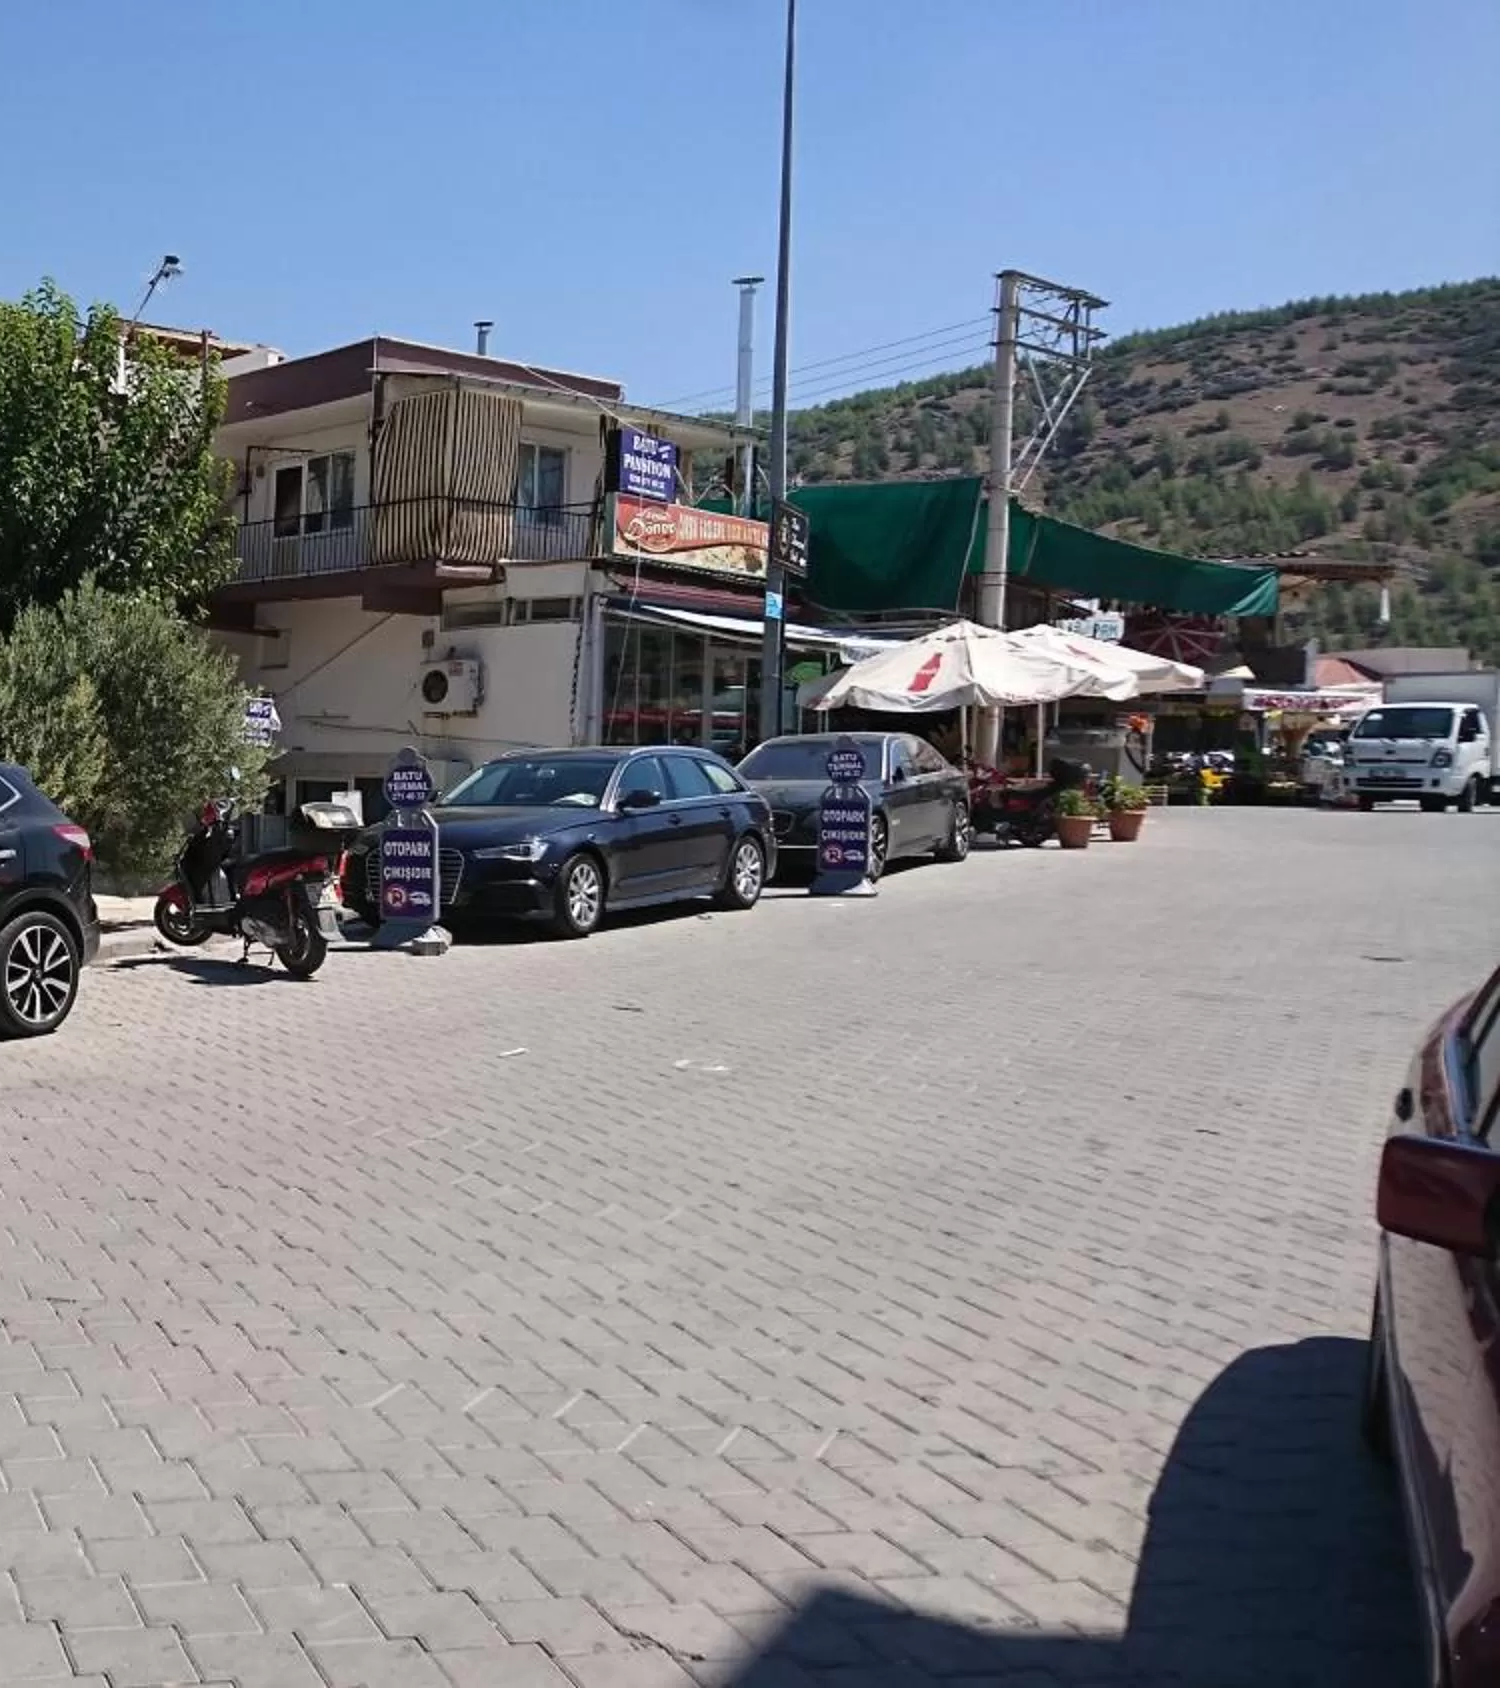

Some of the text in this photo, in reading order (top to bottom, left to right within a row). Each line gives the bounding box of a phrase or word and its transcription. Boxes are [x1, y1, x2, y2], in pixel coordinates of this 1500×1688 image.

[393, 771, 423, 781] BATU
[387, 781, 429, 791] TERMAL
[822, 809, 865, 823] OTOPARK
[383, 841, 431, 857] OTOPARK
